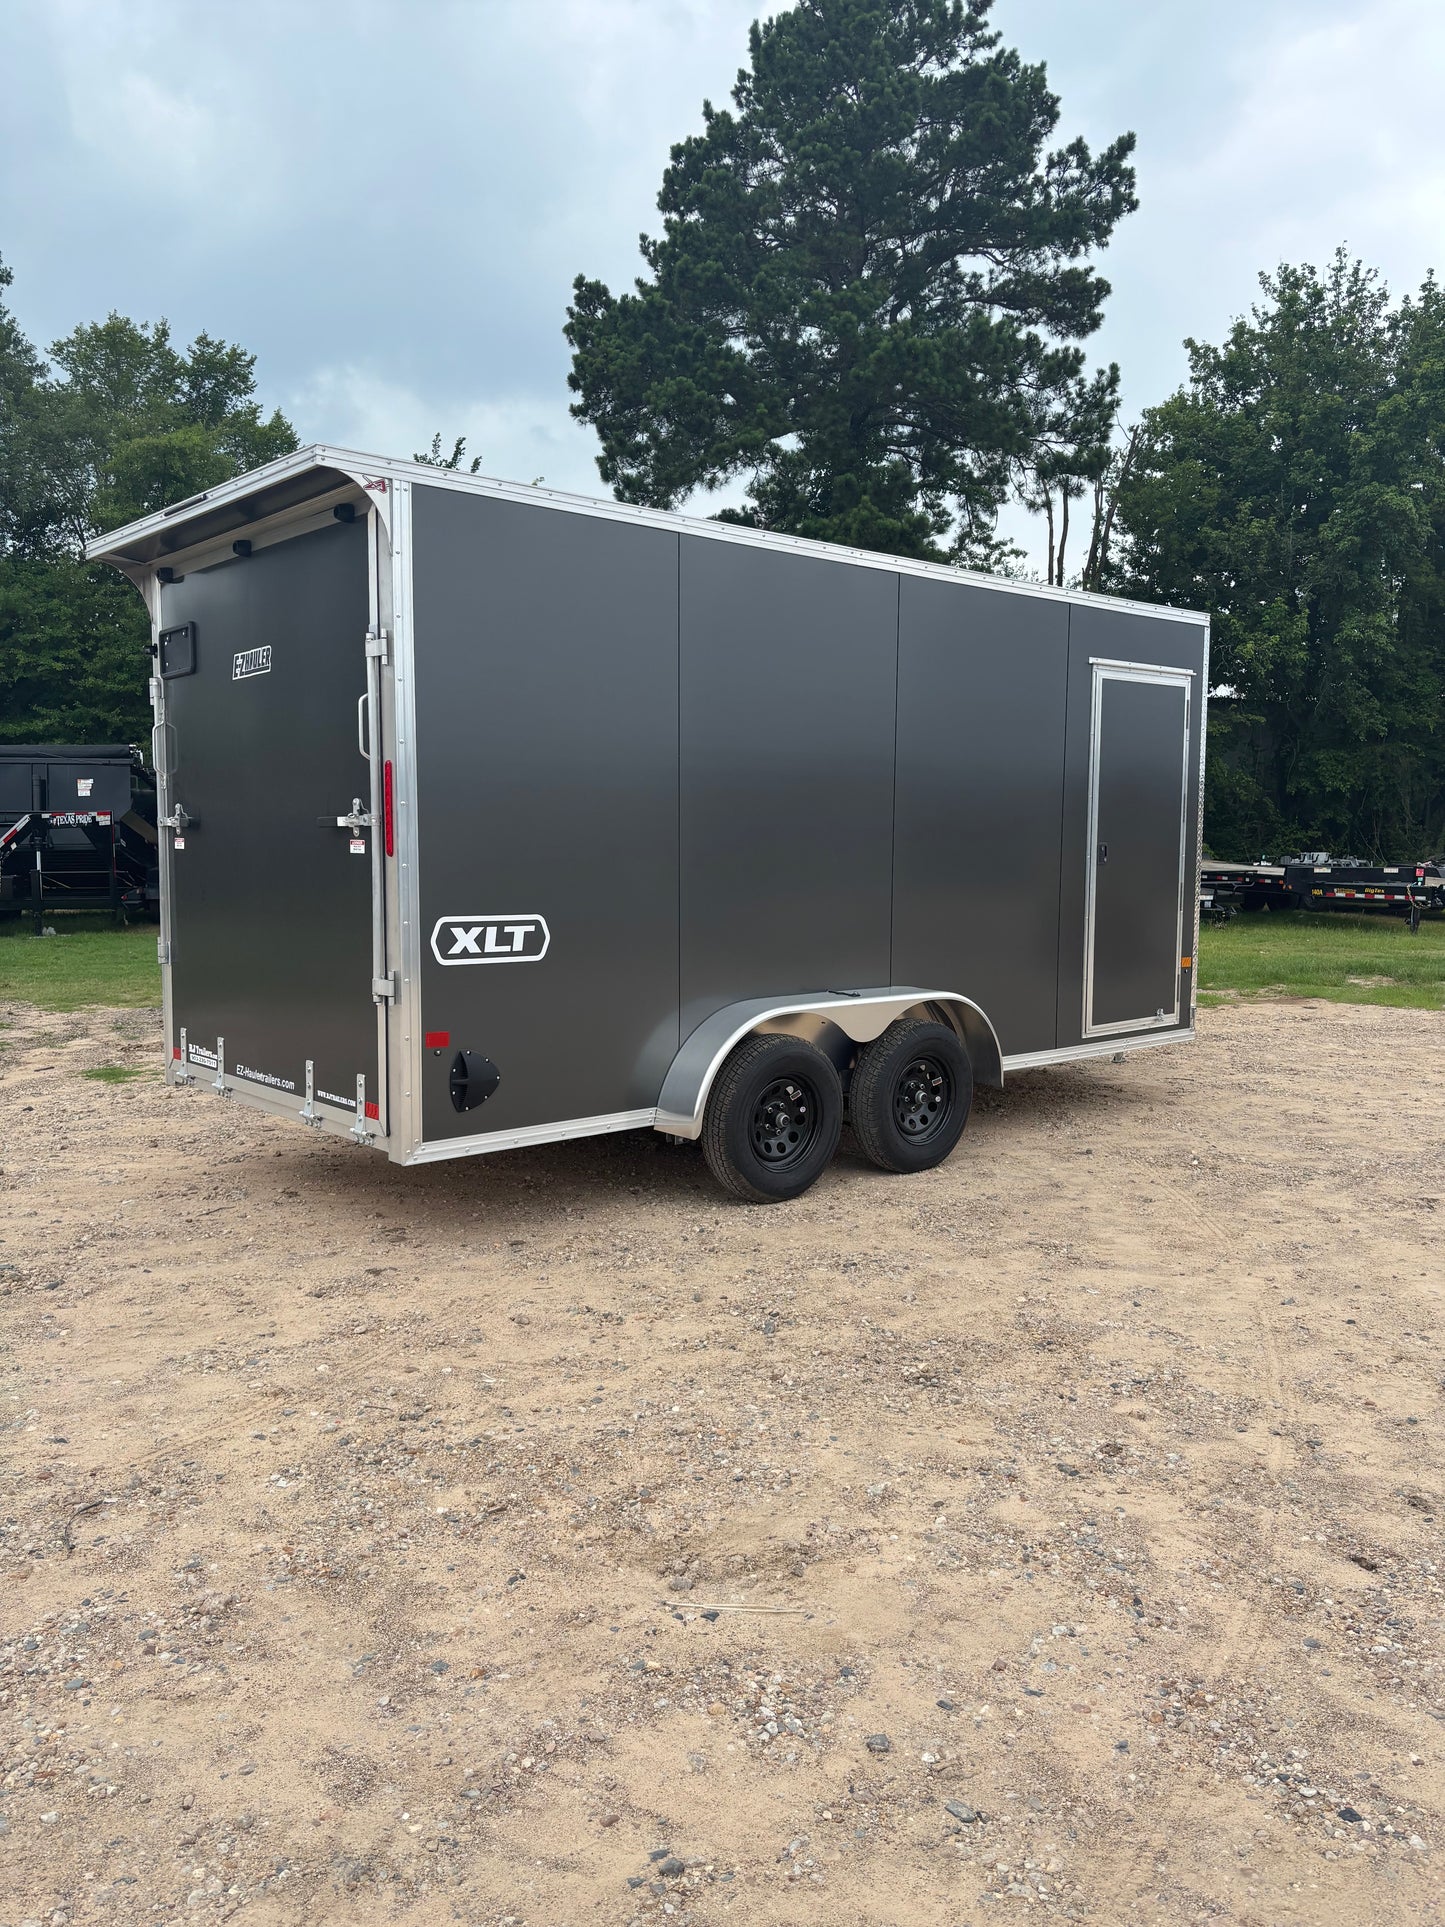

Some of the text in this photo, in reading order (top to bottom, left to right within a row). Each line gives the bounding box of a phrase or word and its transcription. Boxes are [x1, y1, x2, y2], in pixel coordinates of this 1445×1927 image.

[56, 814, 76, 827] TEXAS
[75, 814, 93, 826] PRIDE
[447, 925, 536, 955] XLT
